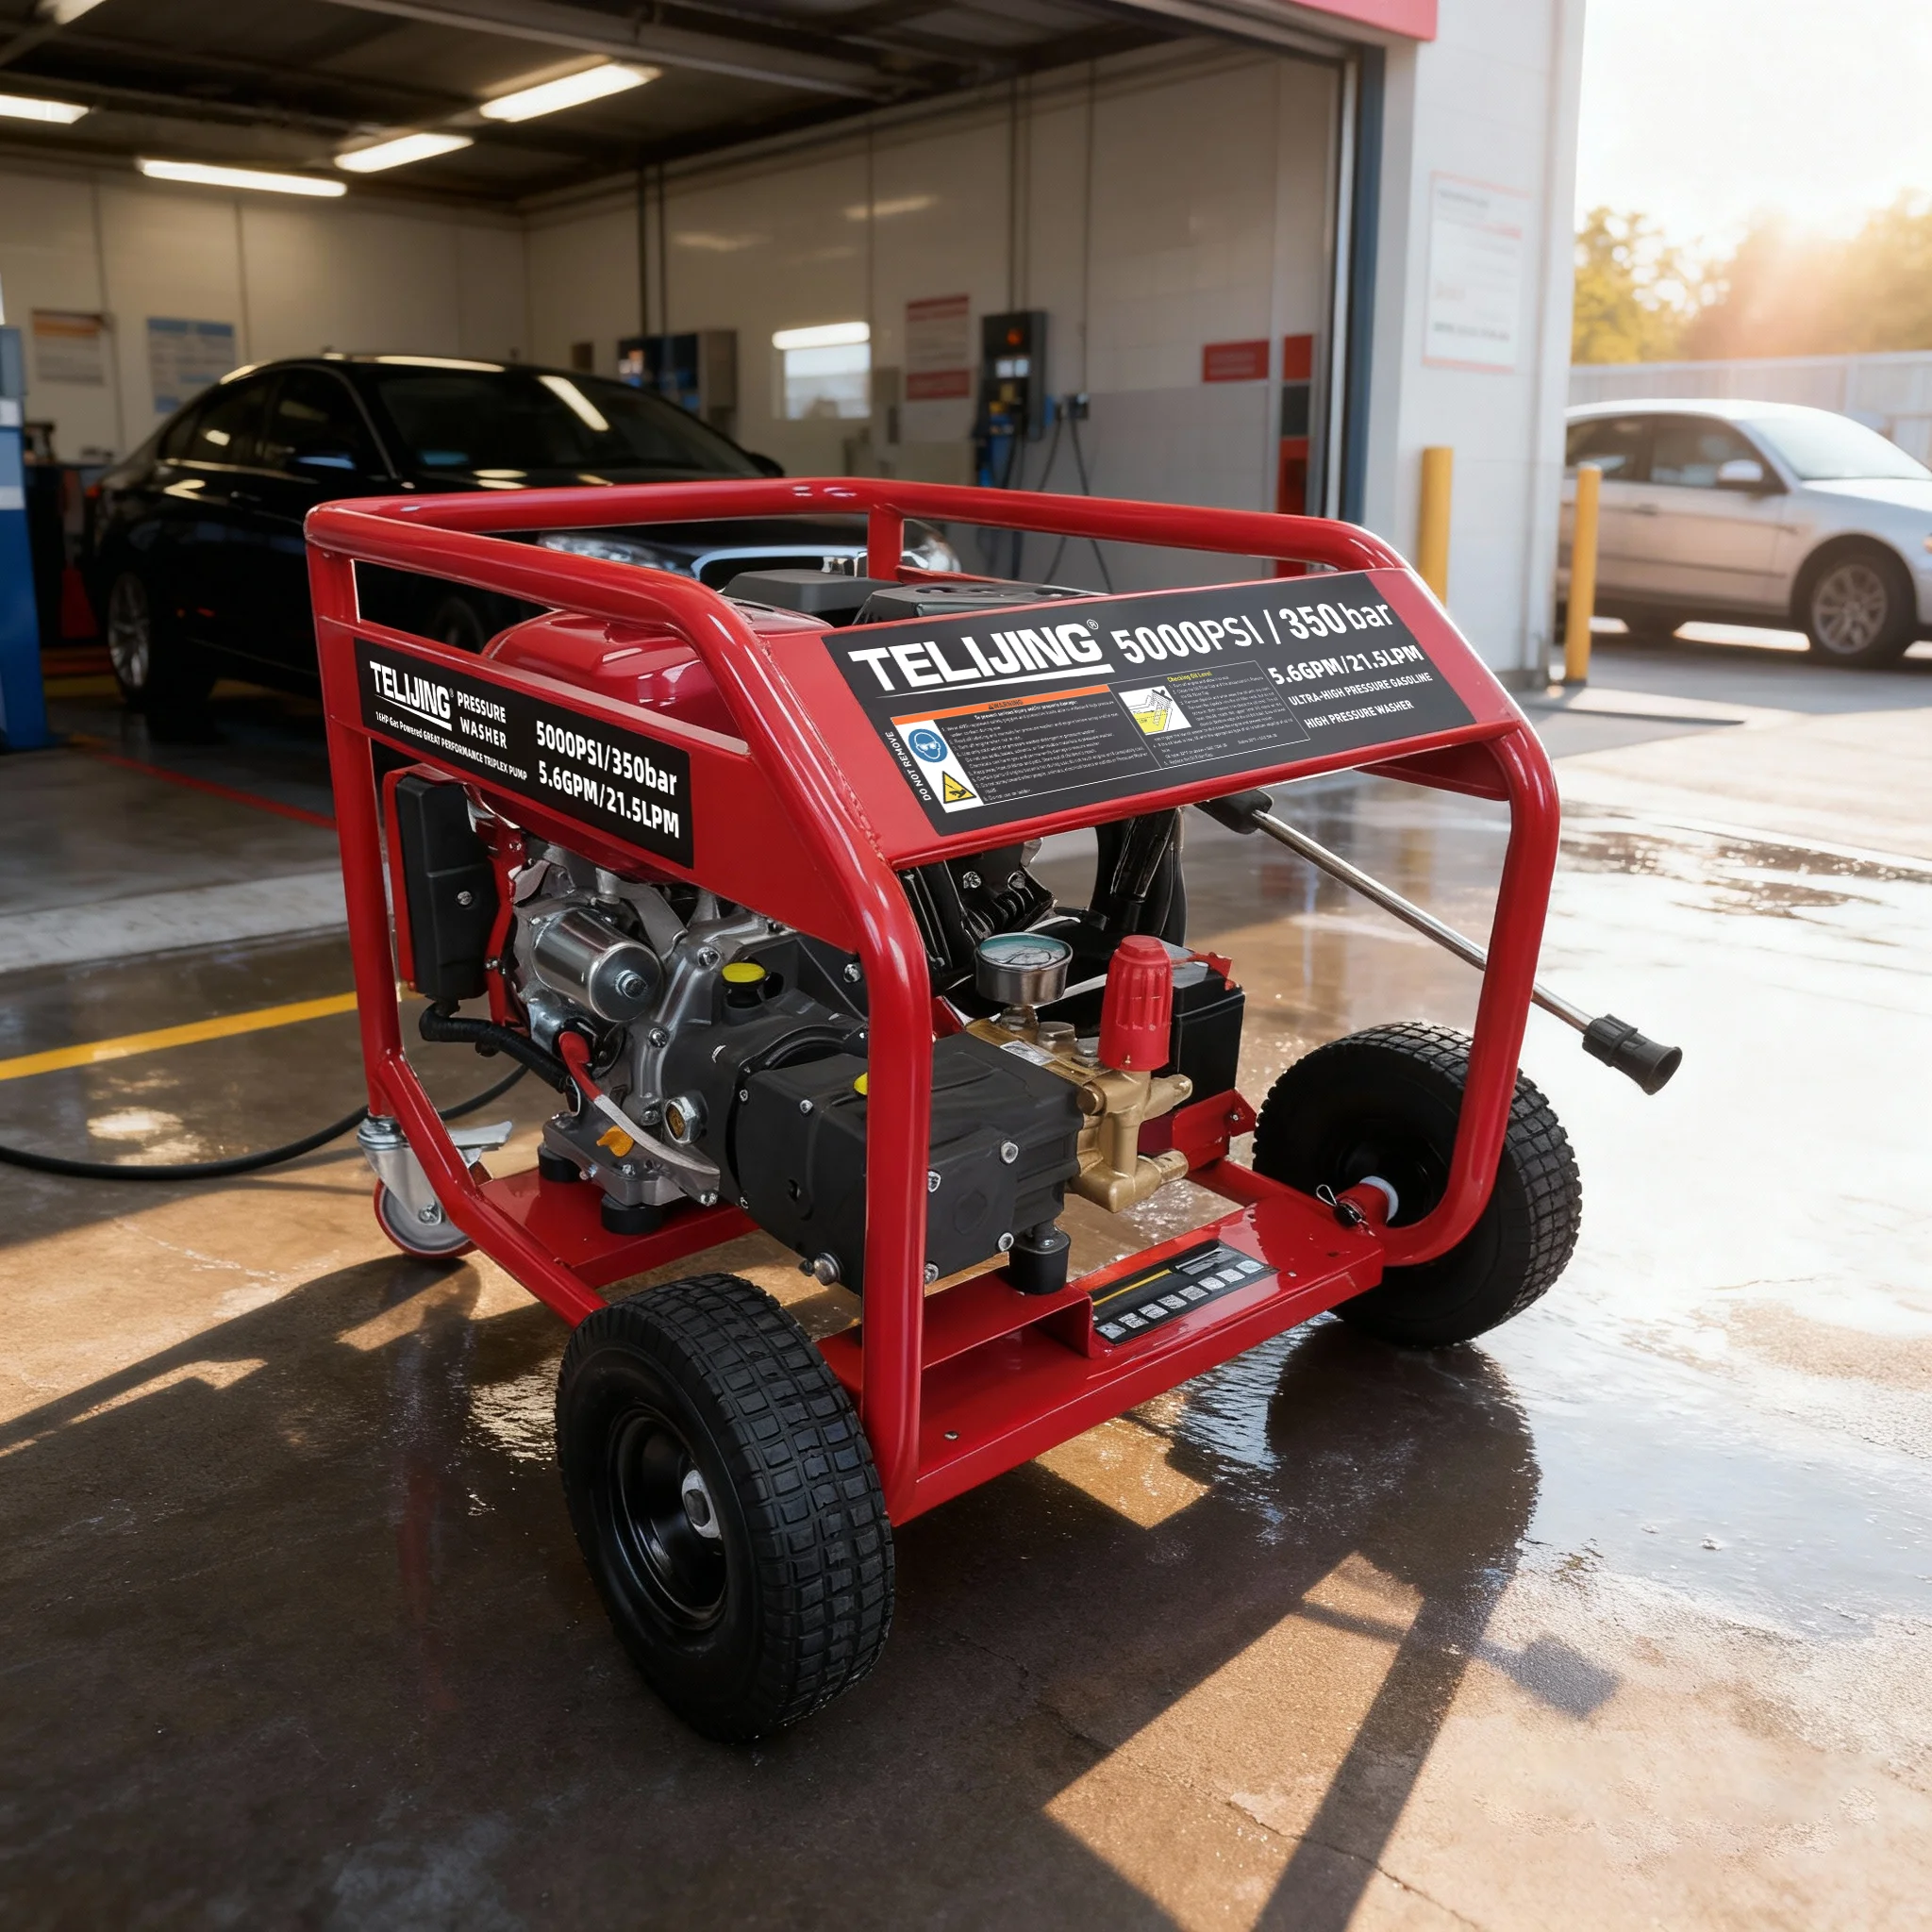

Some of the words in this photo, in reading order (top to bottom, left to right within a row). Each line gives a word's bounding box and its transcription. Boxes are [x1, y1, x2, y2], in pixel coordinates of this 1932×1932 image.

[1110, 615, 1264, 663] 5000PSI
[1279, 603, 1347, 640] 350
[1337, 602, 1393, 630] bar
[1268, 645, 1424, 685] 5.6GPM/21.5LPM
[1288, 688, 1346, 706] ULTRA-HIGH
[1345, 679, 1391, 697] PRESSURE
[1390, 673, 1433, 688] GASOLINE
[457, 691, 507, 724] PRESSURE
[1304, 716, 1330, 728] HIGH
[1328, 707, 1377, 724] PRESSURE
[1374, 700, 1414, 715] WASHER
[389, 717, 399, 728] Gas
[399, 720, 423, 739] Powered
[423, 730, 441, 744] GREAT
[441, 738, 483, 763] PERFORMANCE
[483, 755, 508, 774] TRIPLEX
[508, 765, 527, 781] PUMP
[459, 716, 508, 750] WASHER
[885, 731, 912, 767] REMOVE
[536, 720, 677, 795] 5000PSI/350bar
[907, 769, 924, 787] NOT
[919, 788, 932, 801] DO
[539, 760, 679, 839] 5.6GPM/21.5LPM
